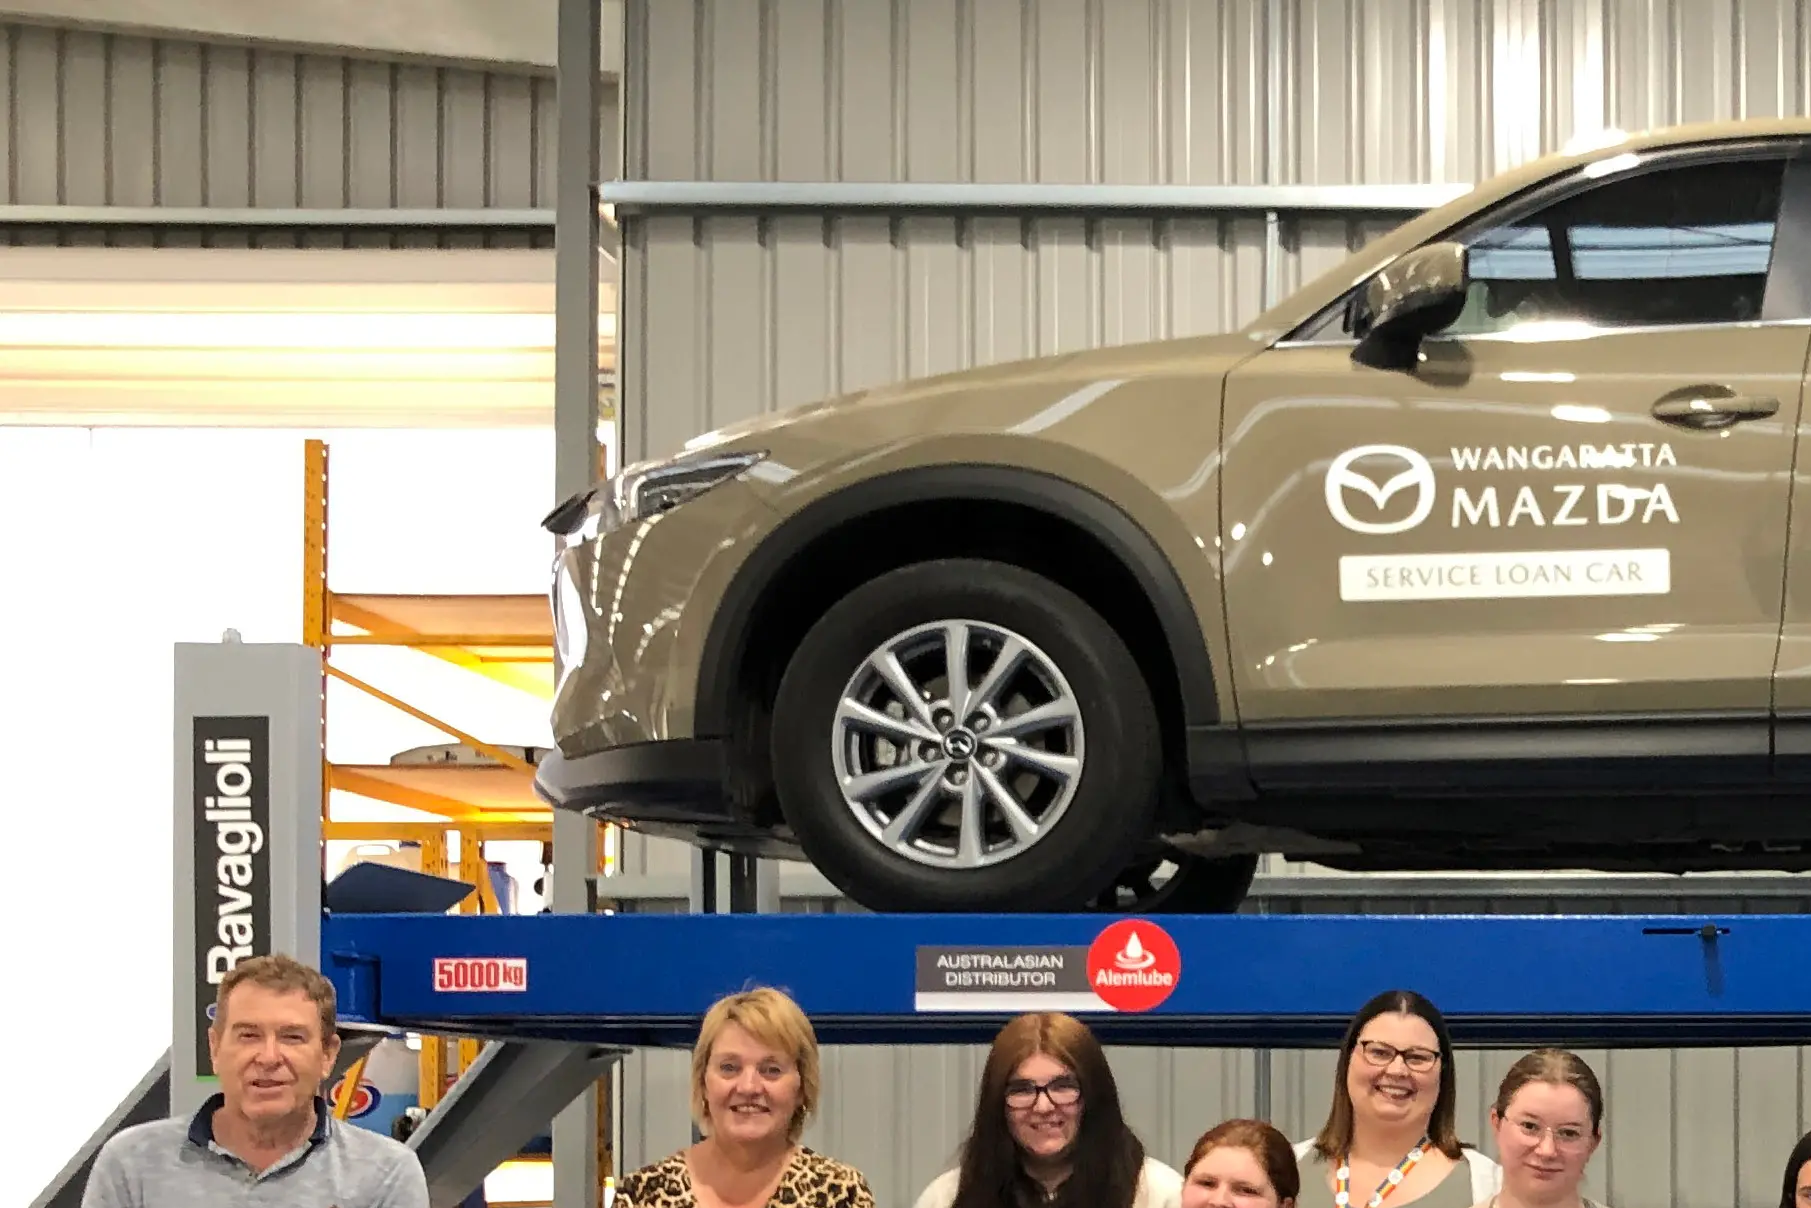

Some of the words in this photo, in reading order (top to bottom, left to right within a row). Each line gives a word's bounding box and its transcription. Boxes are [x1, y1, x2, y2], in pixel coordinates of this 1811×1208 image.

[1450, 443, 1677, 471] WANGARATTA
[1451, 483, 1680, 528] MAZDA
[1366, 563, 1481, 588] SERVICE
[1496, 561, 1572, 586] LOAN
[1586, 561, 1643, 583] CAR
[204, 738, 263, 984] Ravaglioli
[937, 954, 1063, 969] AUSTRALASIAN
[945, 971, 1055, 986] DISTRIBUTOR
[1096, 968, 1172, 986] Alemlube
